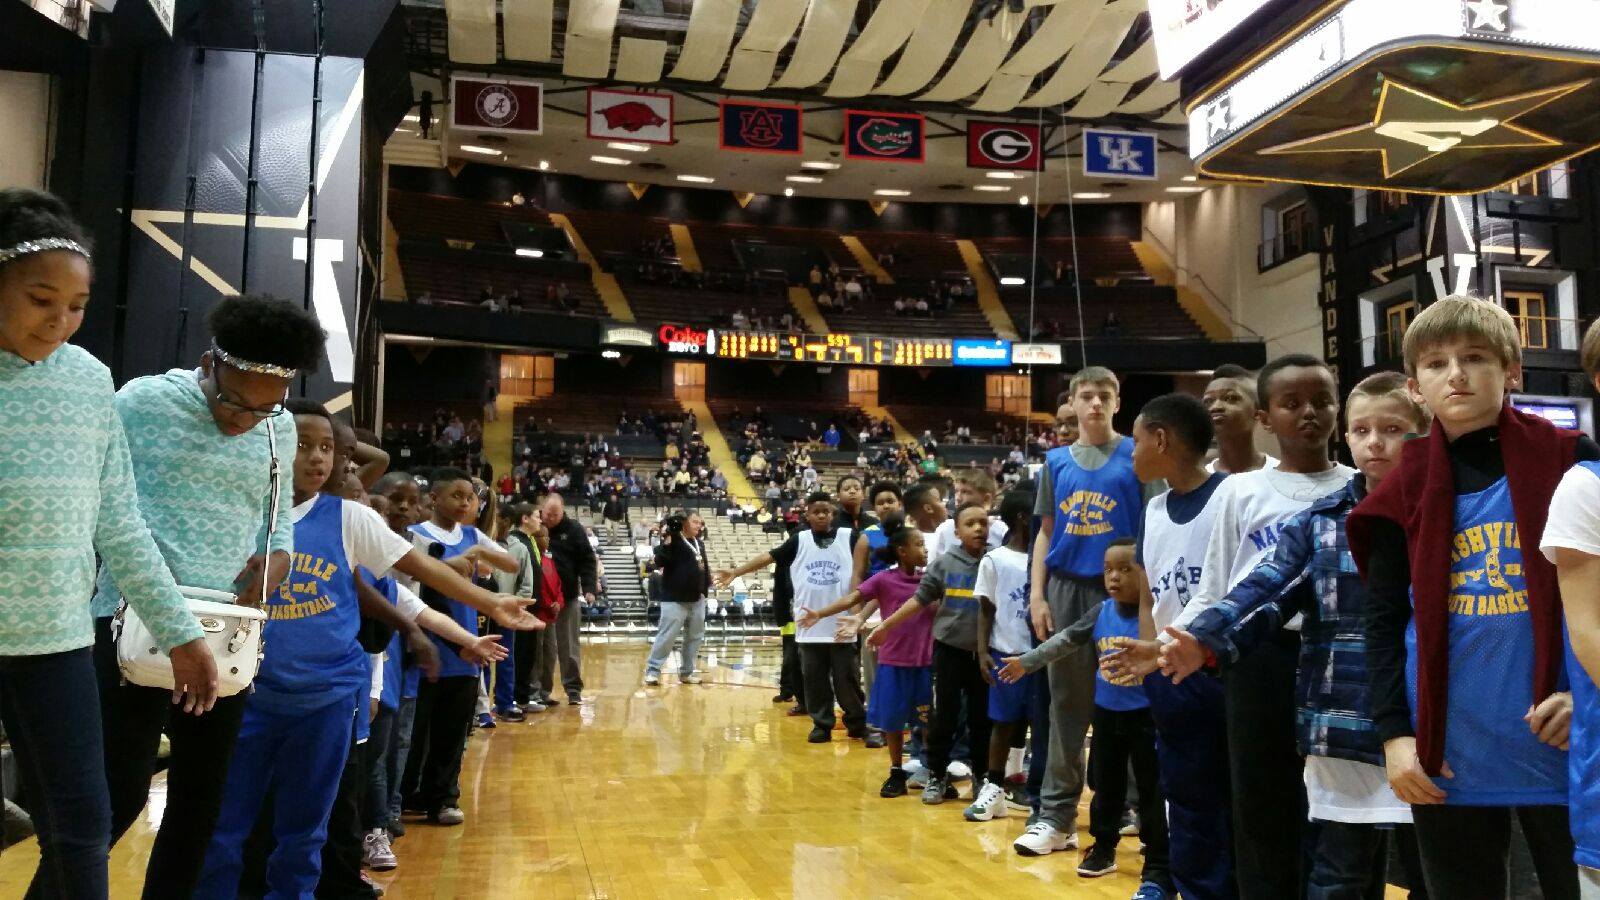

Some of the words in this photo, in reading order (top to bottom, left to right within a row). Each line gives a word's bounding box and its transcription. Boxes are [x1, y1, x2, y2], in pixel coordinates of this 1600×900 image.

[1098, 136, 1144, 172] UK
[659, 324, 706, 347] Coke
[1477, 588, 1529, 617] BASKE
